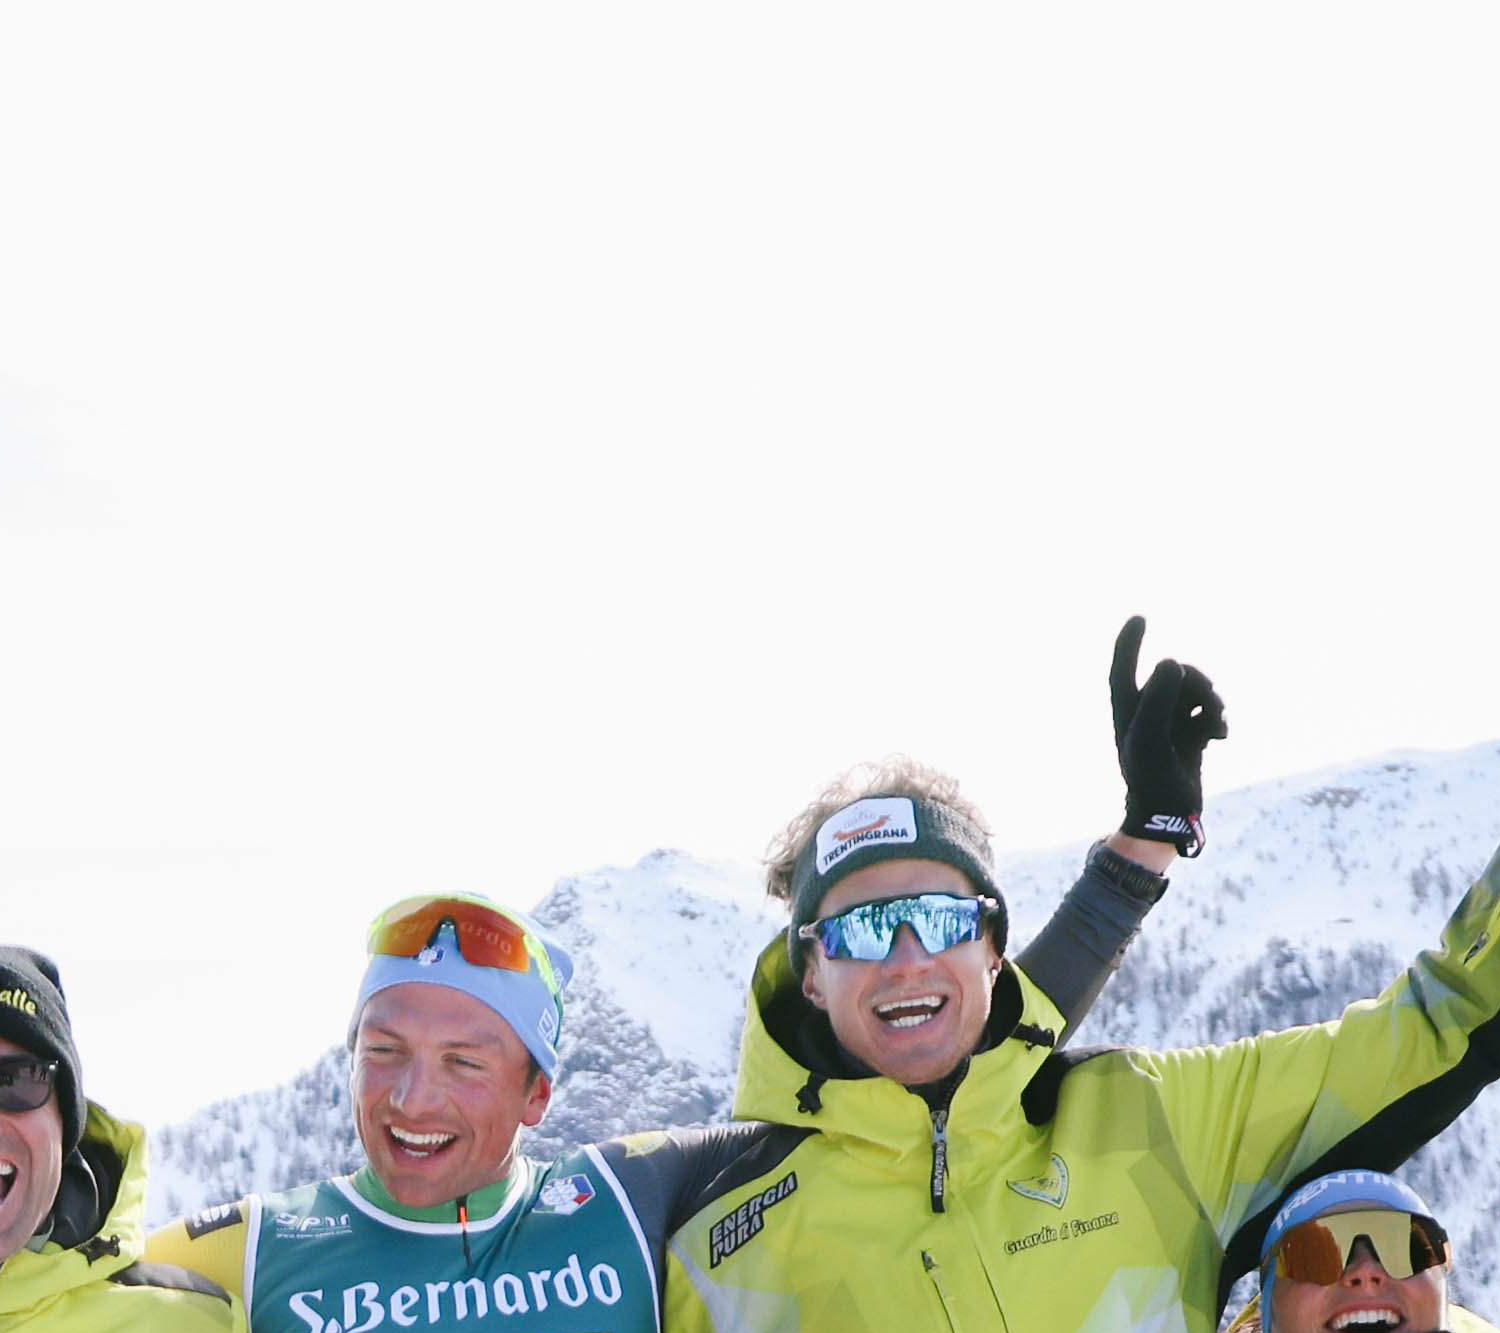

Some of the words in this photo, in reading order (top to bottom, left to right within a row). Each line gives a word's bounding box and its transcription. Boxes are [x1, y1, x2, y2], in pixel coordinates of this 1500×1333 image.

[823, 827, 909, 866] TRENTINGRANA
[711, 1173, 797, 1248] ENERGIA
[1004, 1225, 1059, 1256] Guardia
[1070, 1211, 1120, 1236] Finanza
[710, 1211, 764, 1267] PURA
